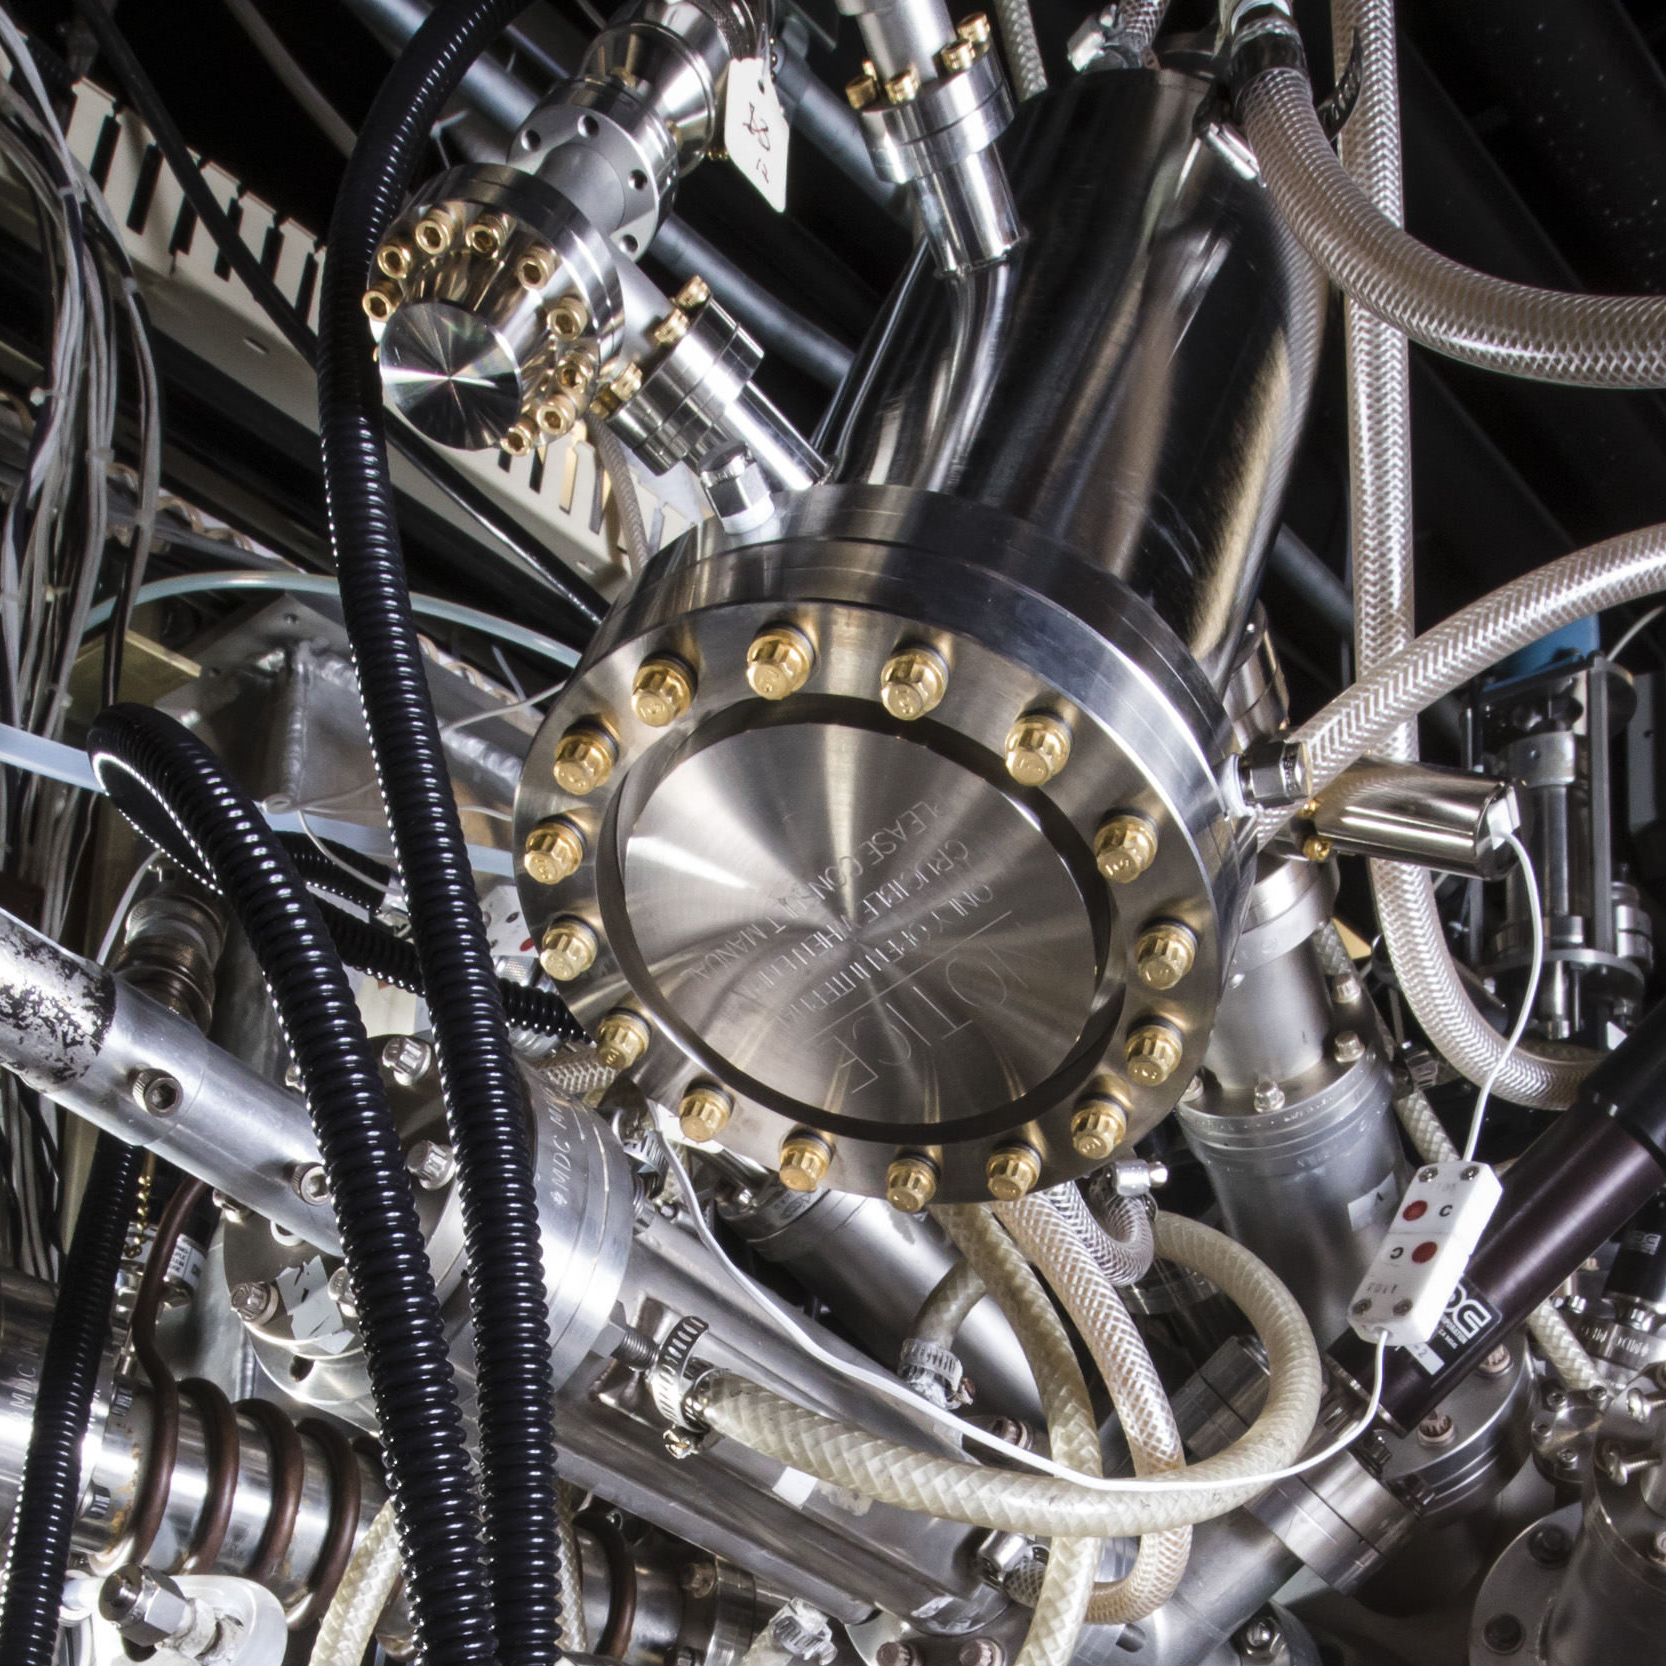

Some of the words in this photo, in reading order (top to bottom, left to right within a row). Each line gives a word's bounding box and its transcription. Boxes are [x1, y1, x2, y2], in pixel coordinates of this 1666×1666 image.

[762, 850, 863, 934] CONSULT
[855, 831, 971, 923] CRUCIBLE
[928, 875, 996, 933] ONLY
[677, 920, 765, 992] MANUAL
[790, 913, 855, 969] WHEN
[863, 917, 931, 974] OPEN
[811, 916, 1058, 1100] NOTICE
[1438, 1201, 1454, 1219] C
[1388, 1243, 1406, 1262] C
